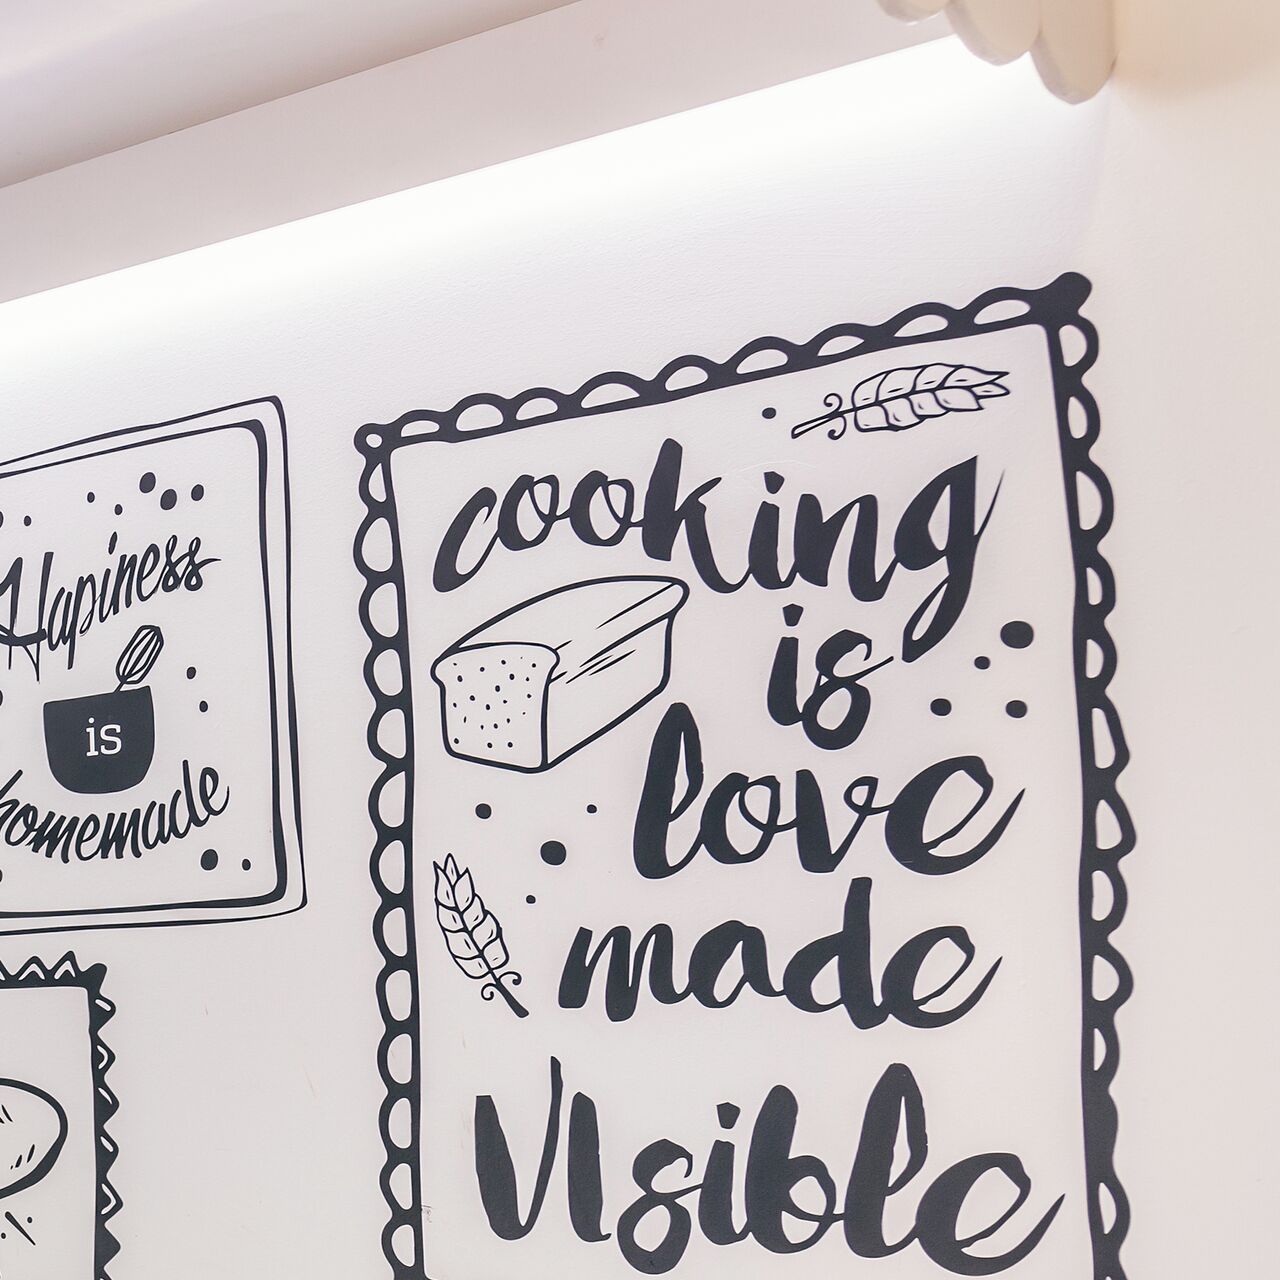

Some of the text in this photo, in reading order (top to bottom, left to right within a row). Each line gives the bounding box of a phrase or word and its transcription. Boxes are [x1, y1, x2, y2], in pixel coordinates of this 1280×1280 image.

[432, 438, 1005, 663] cooking
[85, 716, 123, 757] is
[766, 603, 895, 751] is
[632, 702, 1026, 880] love
[557, 876, 1003, 1030] made
